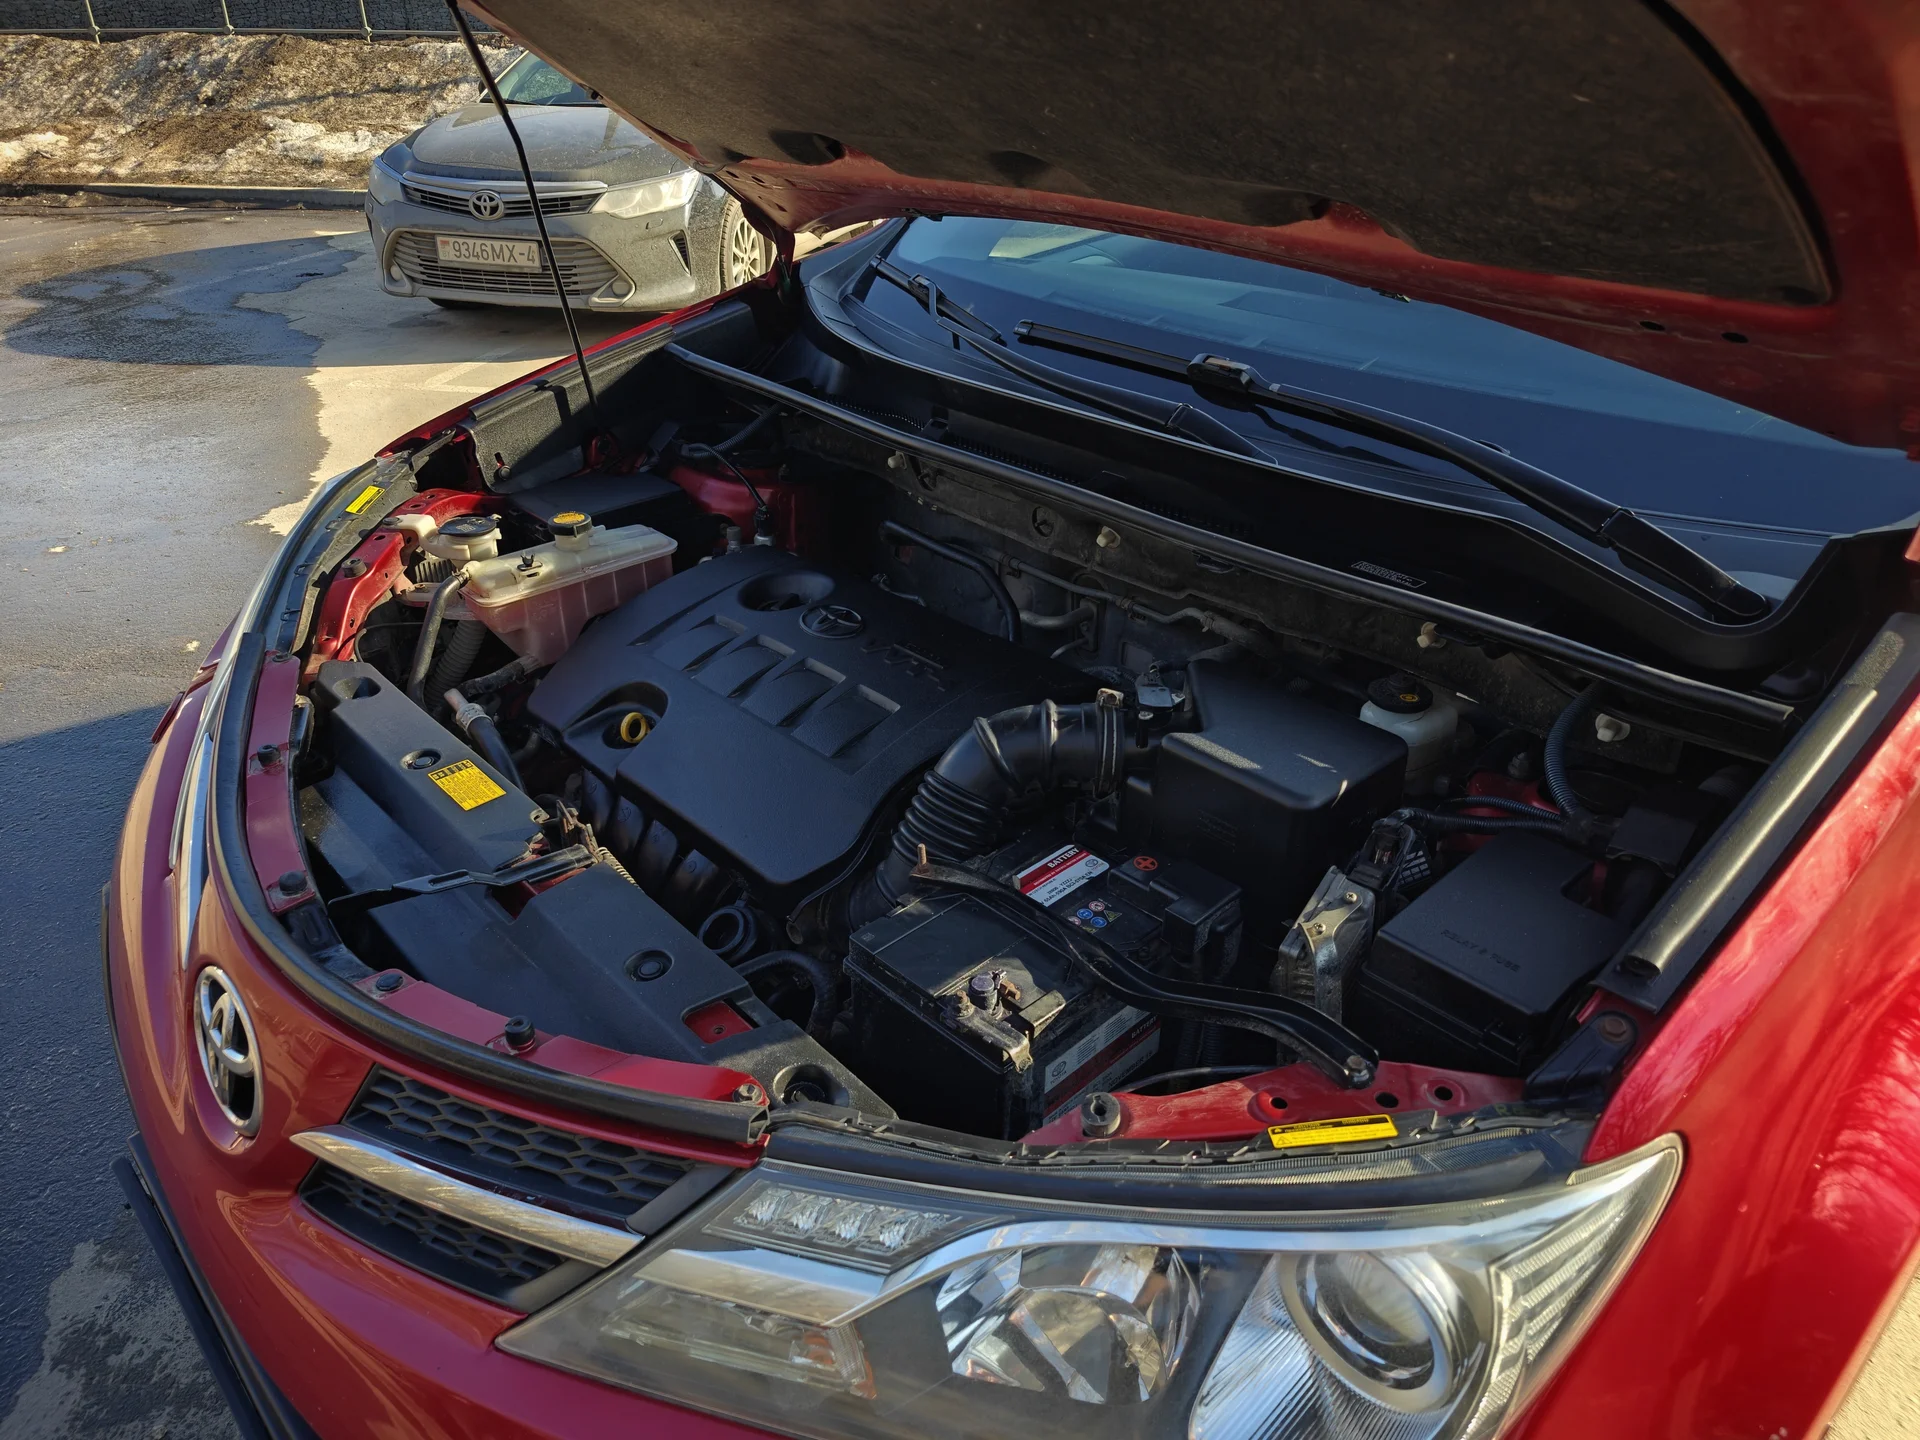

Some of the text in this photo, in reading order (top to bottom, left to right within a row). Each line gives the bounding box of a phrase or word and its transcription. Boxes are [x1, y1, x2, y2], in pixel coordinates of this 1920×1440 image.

[452, 240, 535, 264] 9346MX-4
[1047, 847, 1079, 868] BATTERY
[1441, 929, 1479, 949] RELAY
[1490, 953, 1521, 972] FUSE
[1050, 1070, 1067, 1085] TOYOTA
